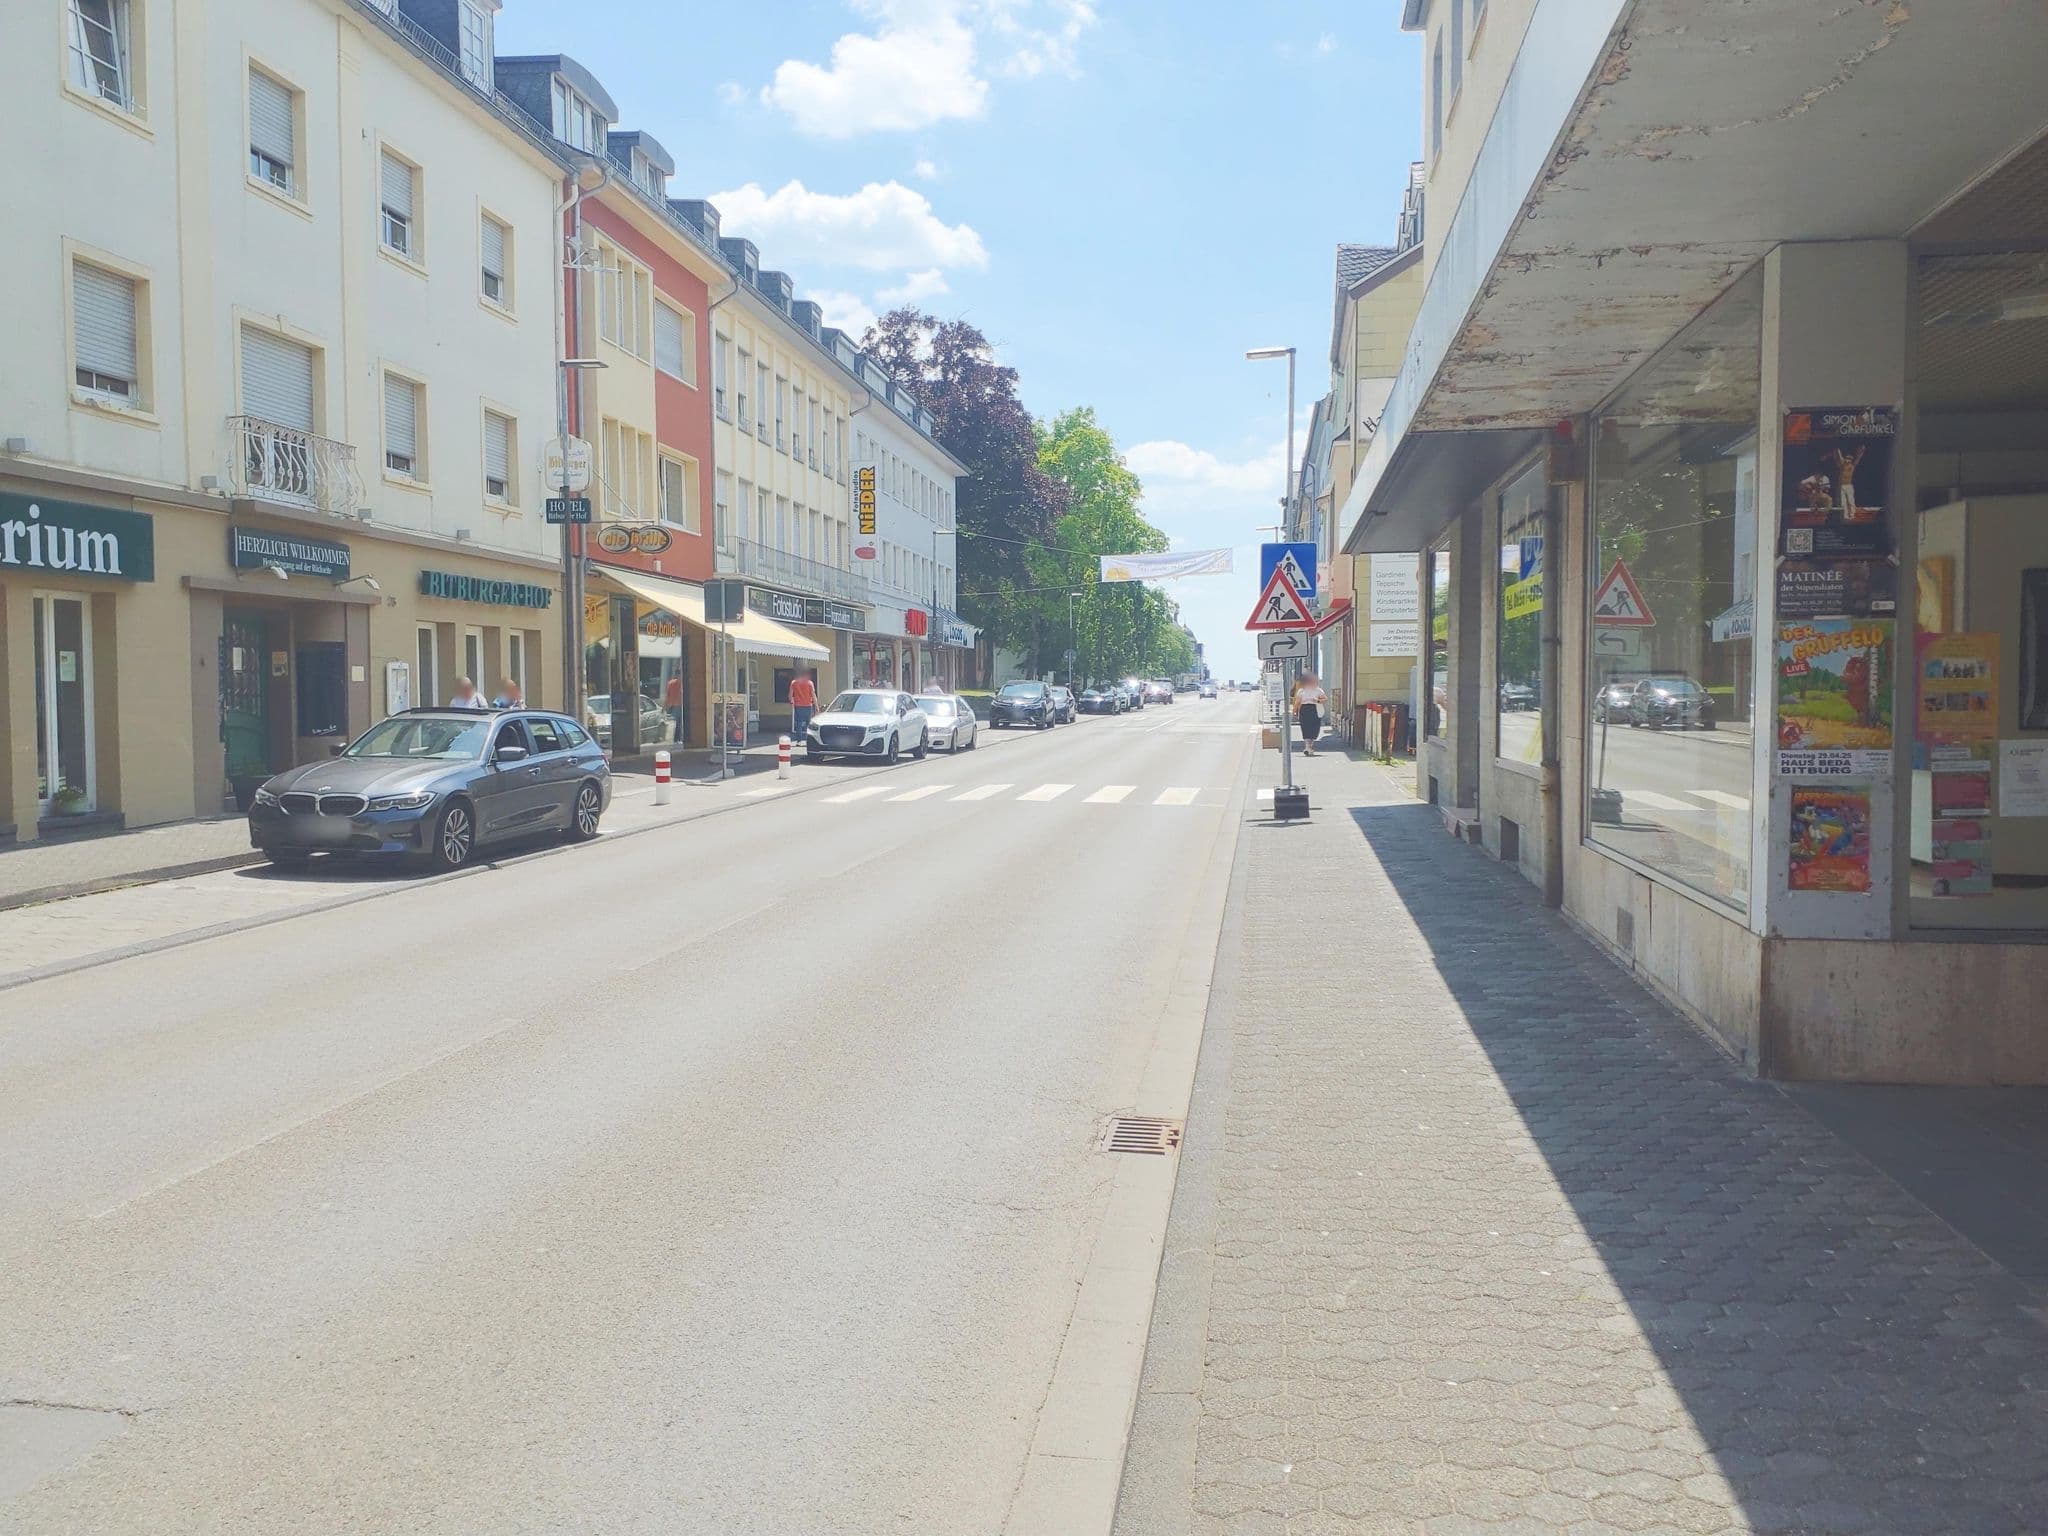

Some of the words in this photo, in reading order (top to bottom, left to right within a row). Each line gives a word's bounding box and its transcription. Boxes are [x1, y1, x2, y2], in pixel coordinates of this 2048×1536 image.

[1823, 414, 1858, 425] SIMON
[1839, 423, 1895, 434] GARFUNKEL
[0, 503, 122, 575] rium
[604, 532, 625, 546] die
[630, 528, 666, 547] brille
[238, 535, 289, 557] HERZLICH
[289, 543, 351, 566] WILLKOMMEN
[1781, 569, 1844, 582] MATINÉE
[429, 571, 552, 609] BITBURGER-HOF
[1781, 584, 1794, 592] der
[772, 594, 803, 619] Fotostudio
[949, 626, 963, 641] LOGOS
[1781, 625, 1813, 642] DER
[1786, 664, 1806, 673] LIVE
[1781, 752, 1816, 760] Dienstag
